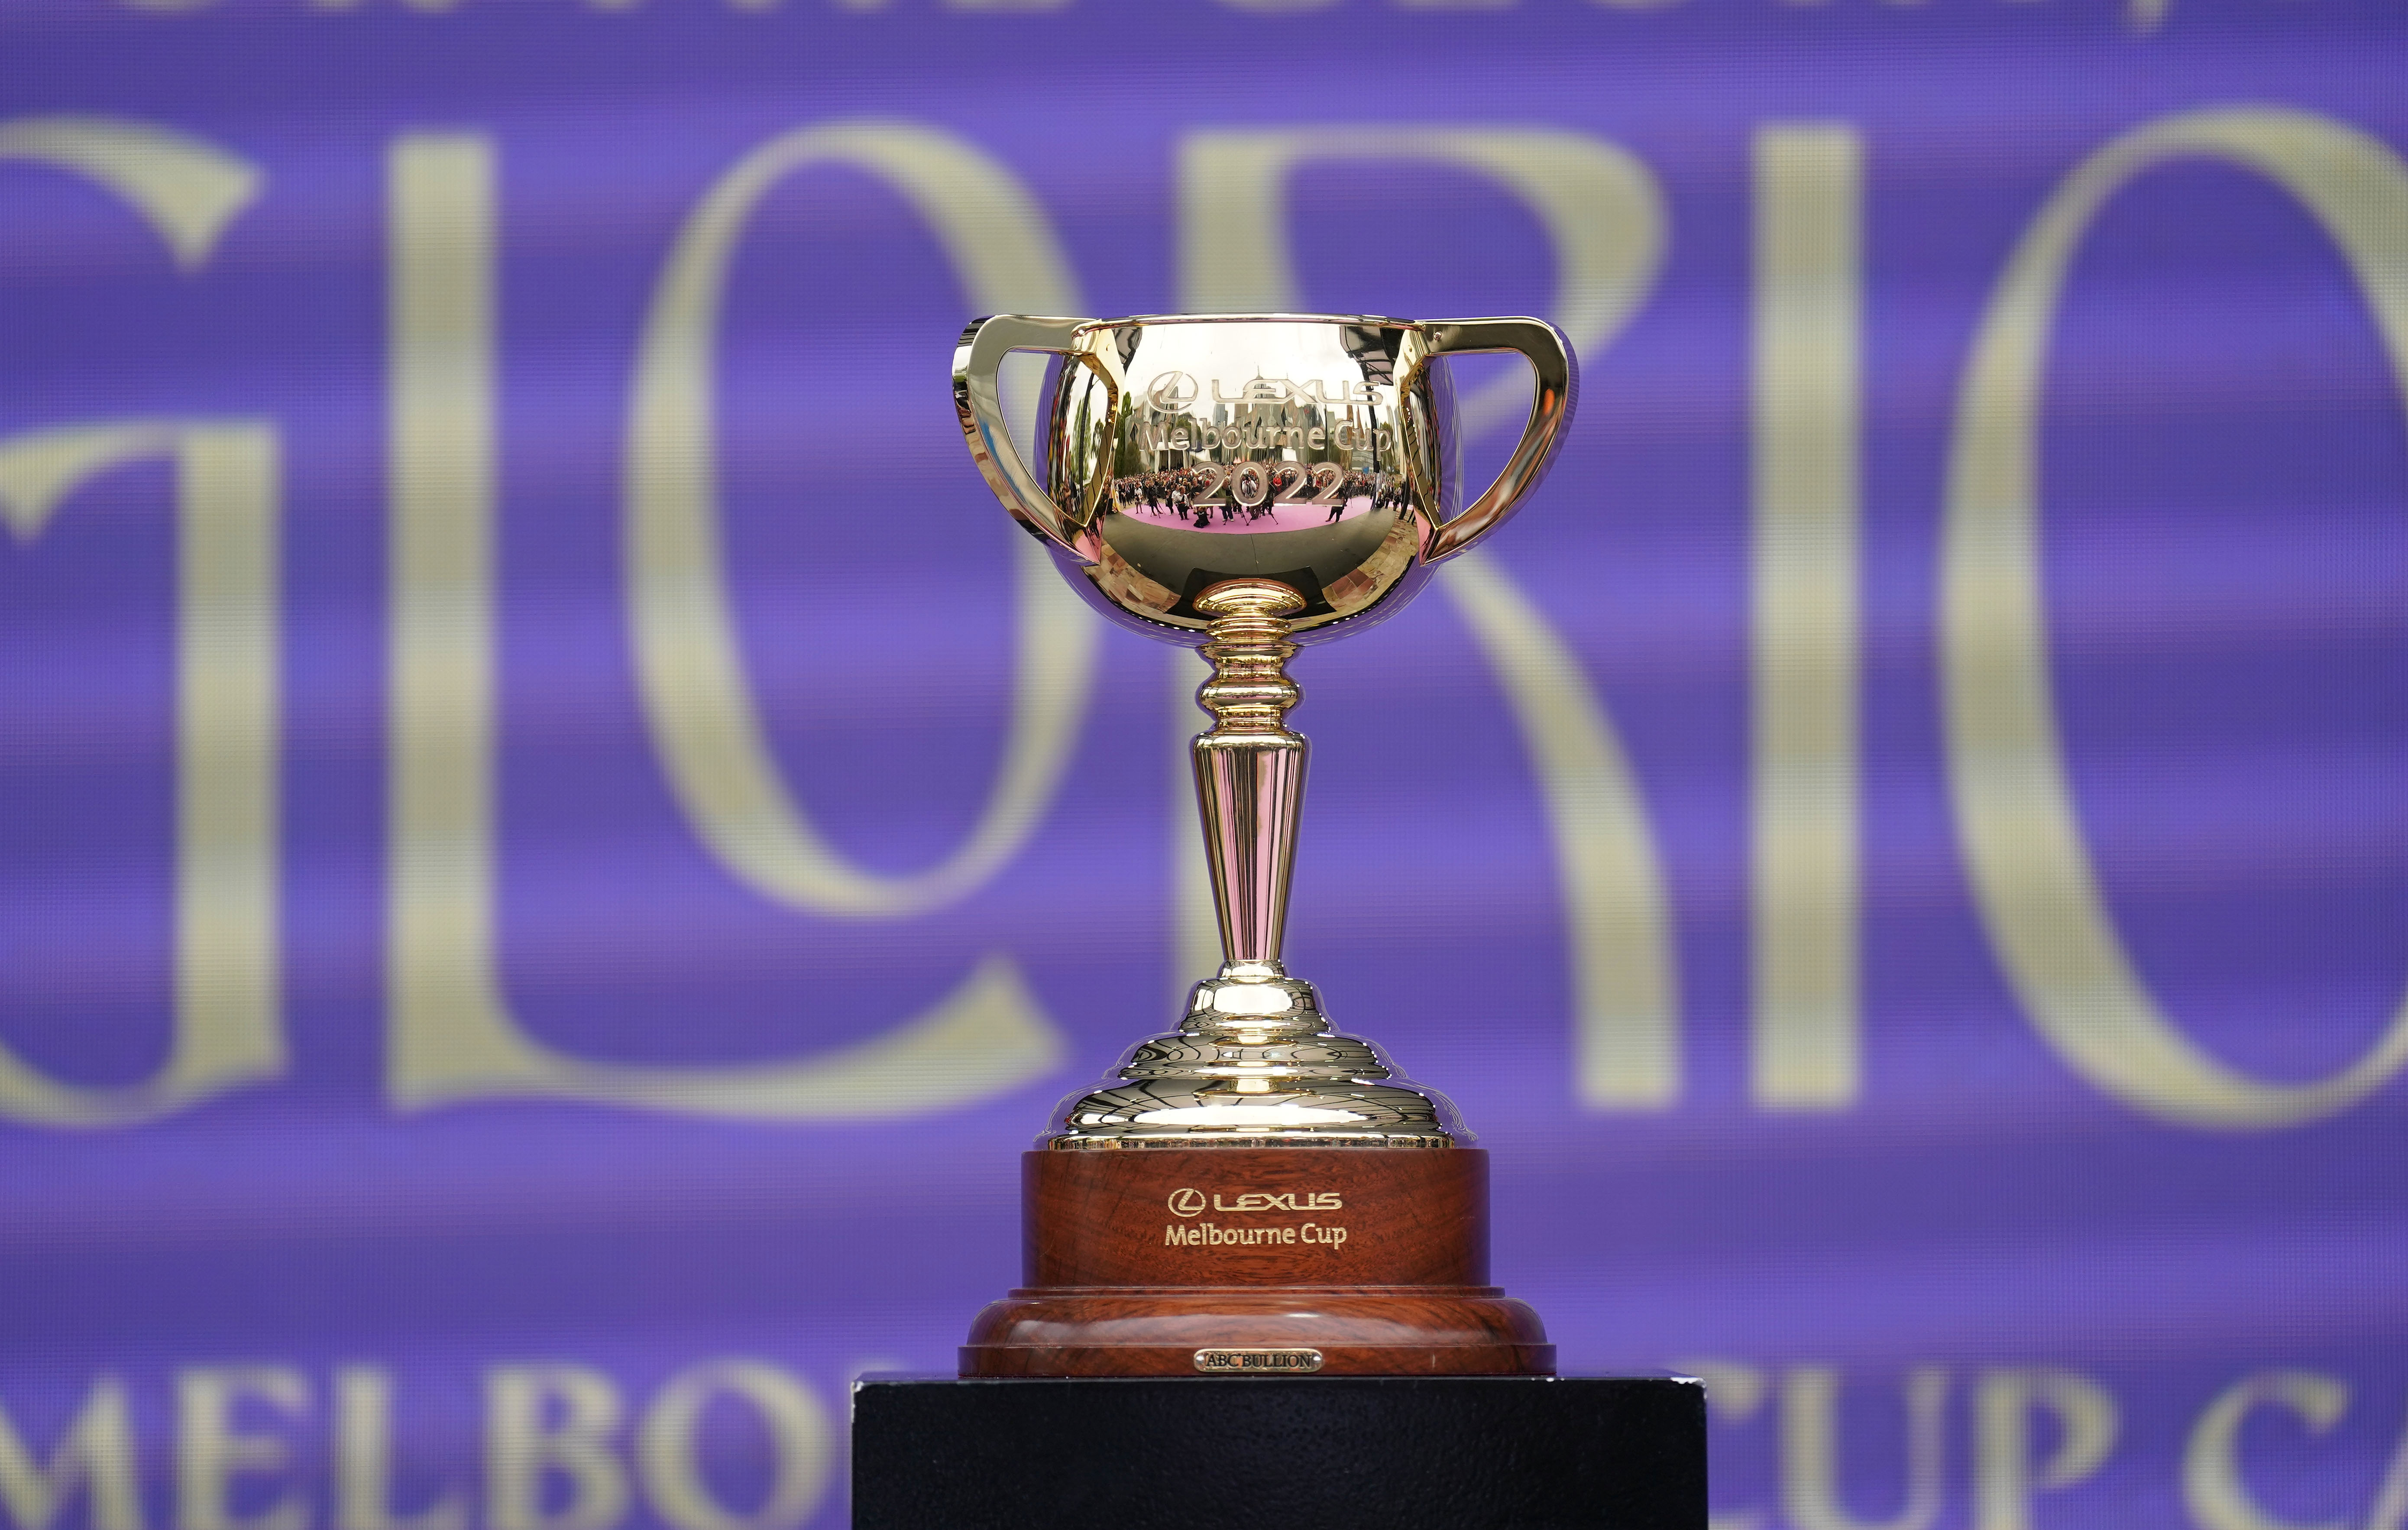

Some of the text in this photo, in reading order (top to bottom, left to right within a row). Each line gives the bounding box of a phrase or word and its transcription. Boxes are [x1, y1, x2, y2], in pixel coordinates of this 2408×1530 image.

[1211, 378, 1384, 405] LEXUS
[1139, 418, 1392, 457] Melbourne Cup
[1192, 460, 1345, 507] 2022
[1213, 1192, 1343, 1212] LEXUS
[1165, 1222, 1347, 1250] Melbourne Cup
[1206, 1354, 1312, 1368] ABC BULLION
[0, 1360, 905, 1530] MELBO
[2183, 1362, 2408, 1530] C
